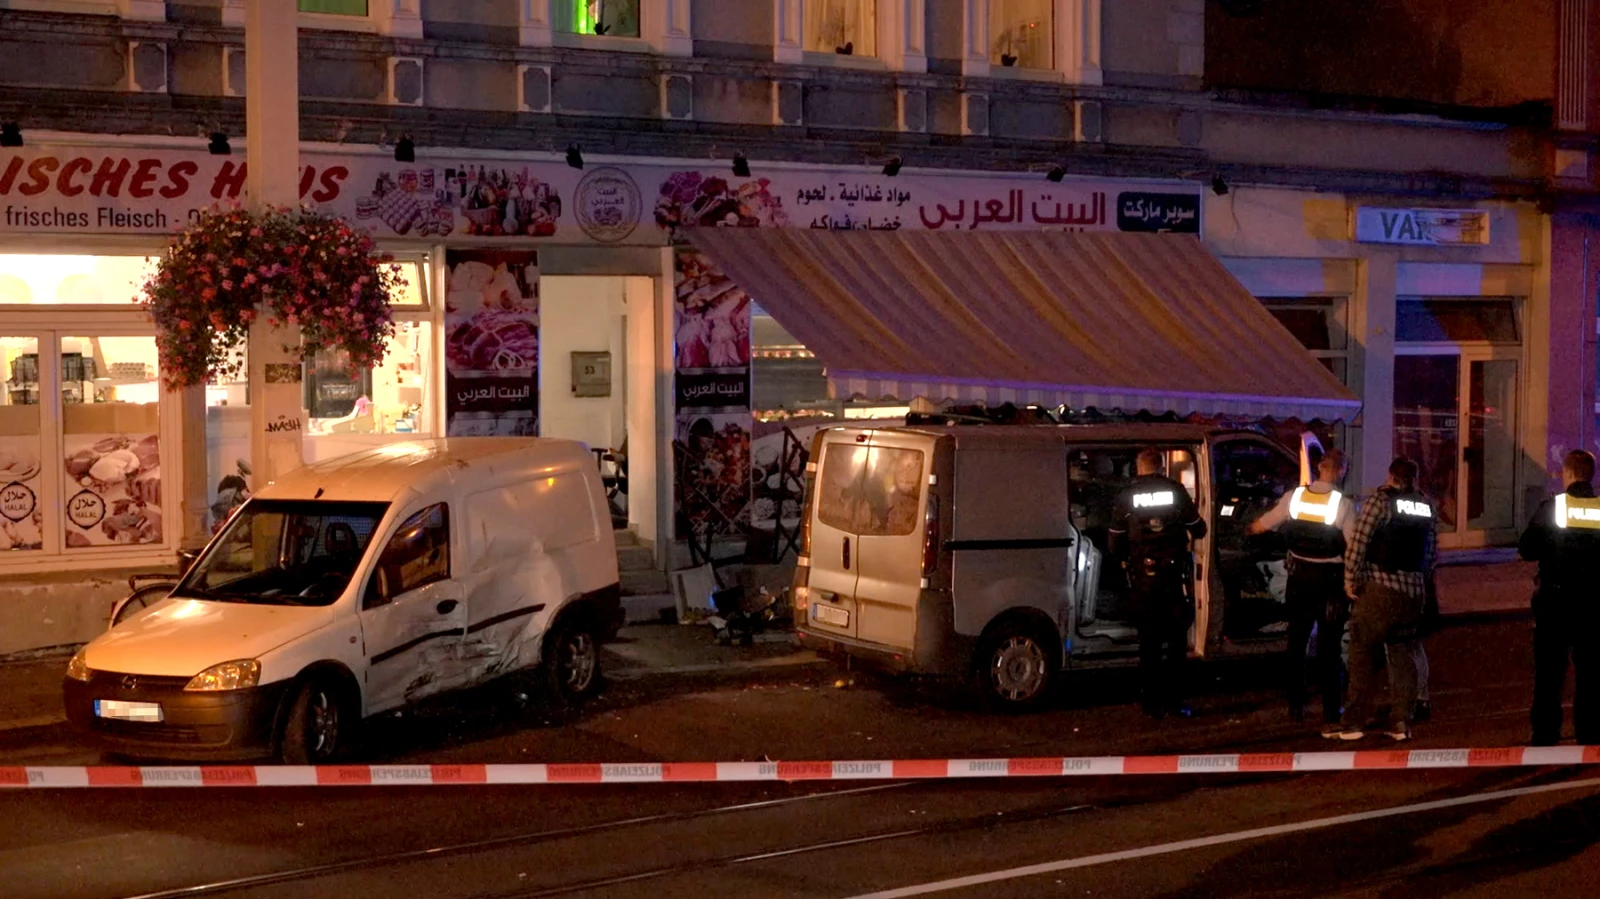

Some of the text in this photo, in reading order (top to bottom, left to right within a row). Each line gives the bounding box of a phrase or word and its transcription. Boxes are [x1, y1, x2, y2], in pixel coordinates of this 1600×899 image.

[0, 155, 349, 203] ISCHES HUS
[796, 184, 827, 205] لحوم
[839, 182, 883, 207] غذائية
[886, 186, 911, 207] مواد
[5, 205, 89, 228] frisches
[97, 206, 167, 229] Fleisch
[1031, 192, 1106, 233] البيت
[456, 384, 530, 406] البيت العربي
[682, 381, 745, 401] البيت العربي
[4, 490, 26, 503] حلال
[74, 498, 97, 510] حلال
